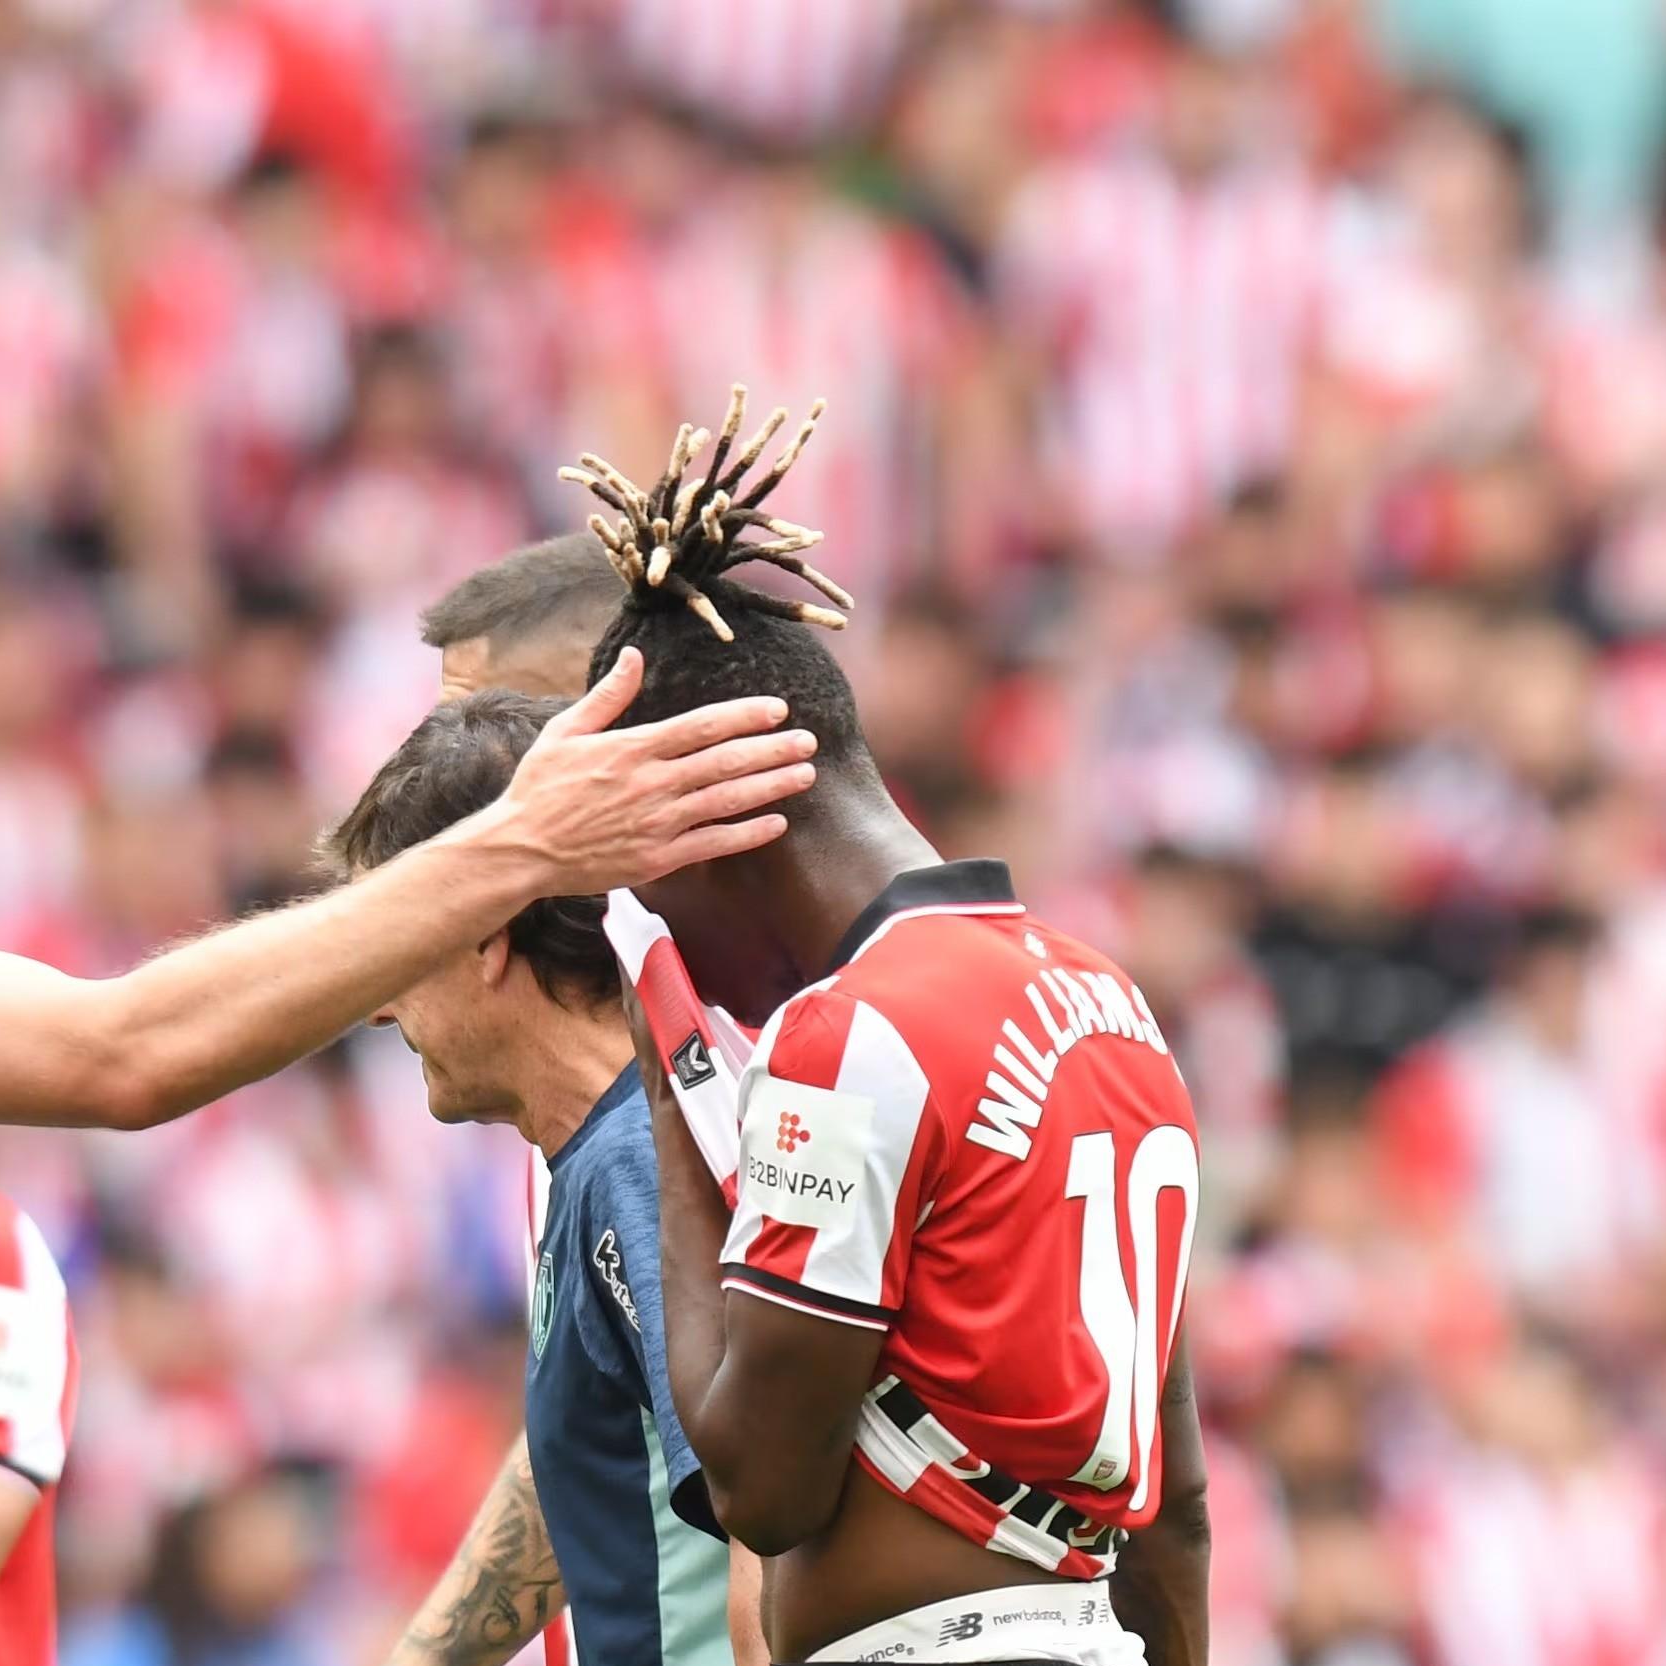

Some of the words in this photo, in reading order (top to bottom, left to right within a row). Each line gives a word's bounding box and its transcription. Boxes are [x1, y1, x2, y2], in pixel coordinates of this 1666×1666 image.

[965, 967, 1169, 1162] WILLIAMS
[749, 1156, 855, 1204] B2BINPAY
[1065, 1124, 1200, 1511] 10
